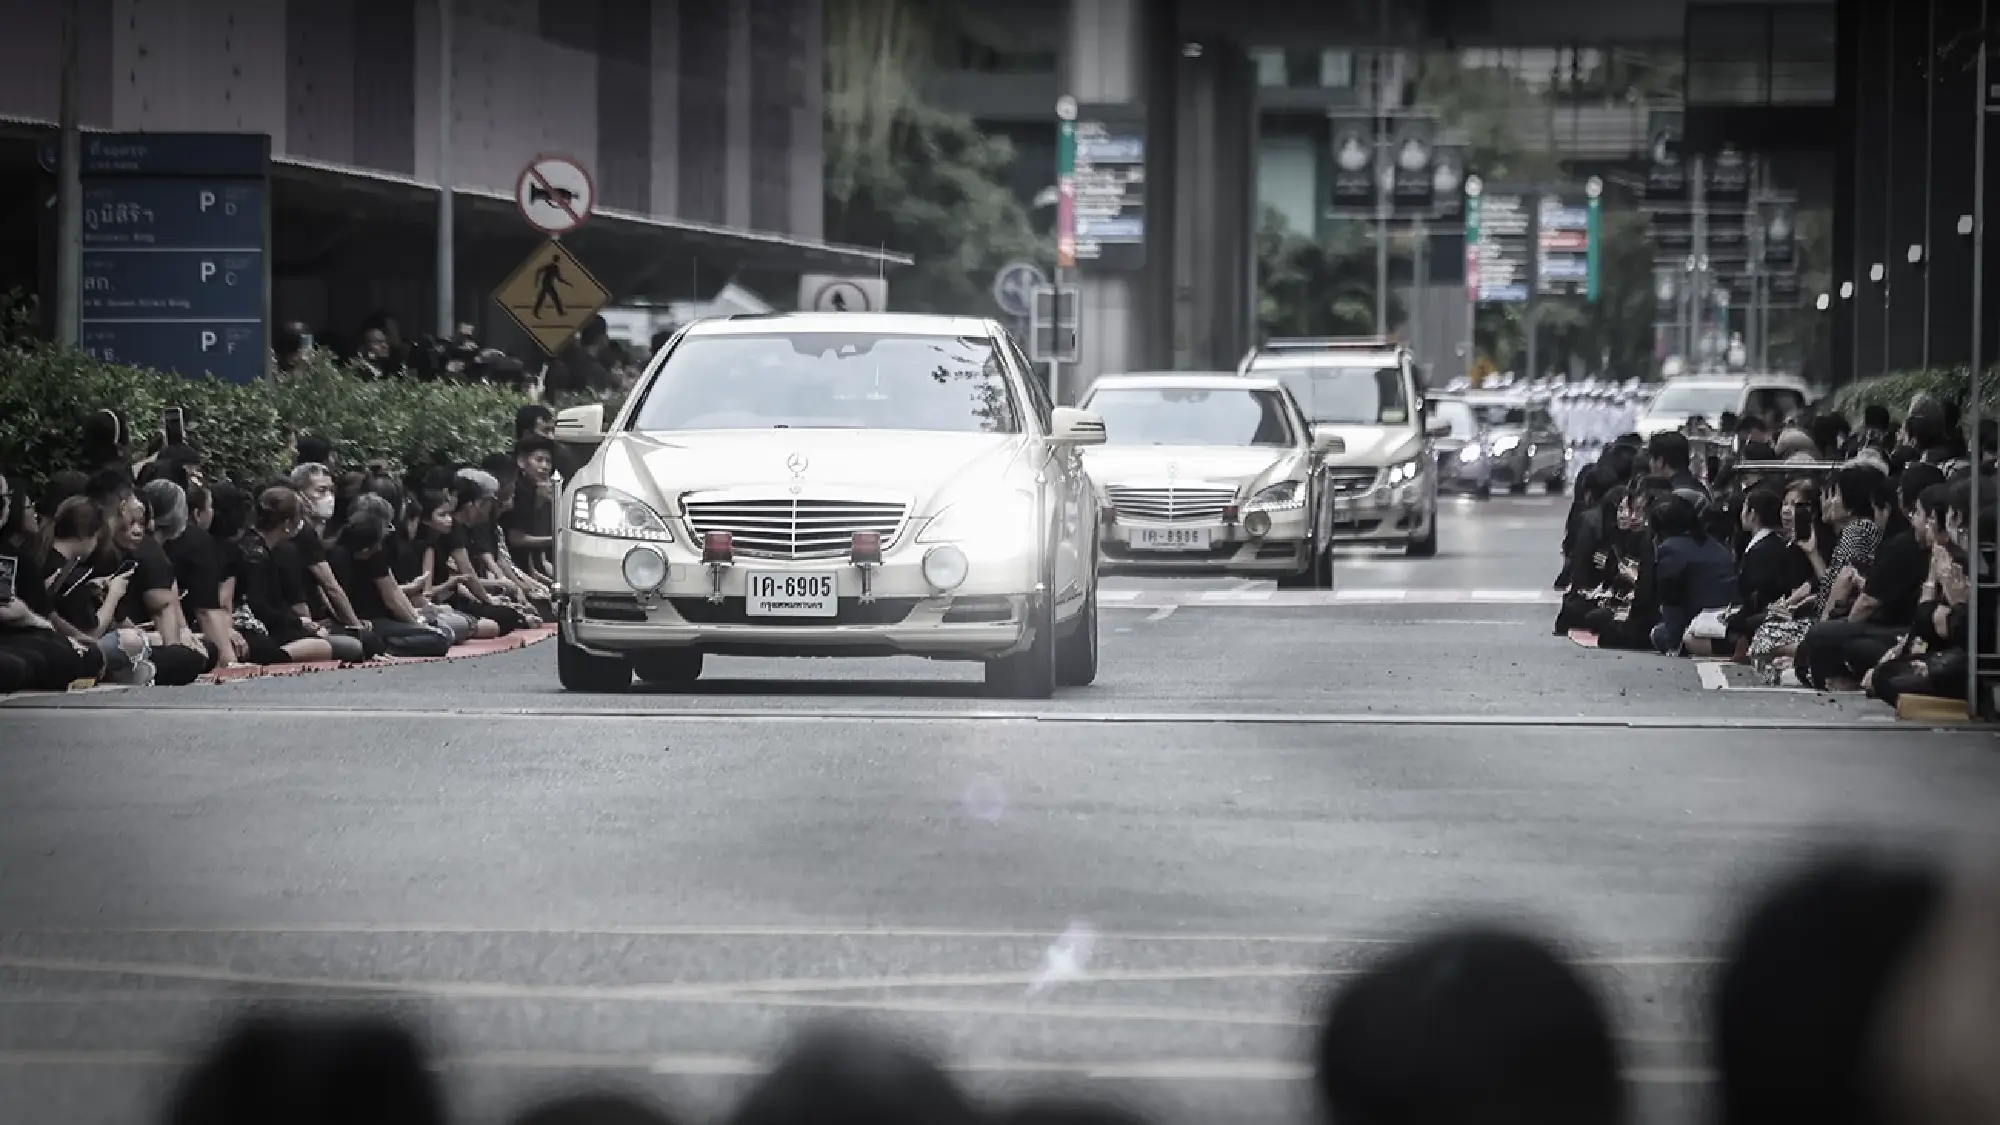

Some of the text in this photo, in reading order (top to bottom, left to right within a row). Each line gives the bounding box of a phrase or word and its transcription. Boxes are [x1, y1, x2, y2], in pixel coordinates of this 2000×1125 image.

[200, 191, 216, 212] P
[201, 261, 217, 283] P
[202, 331, 217, 352] P
